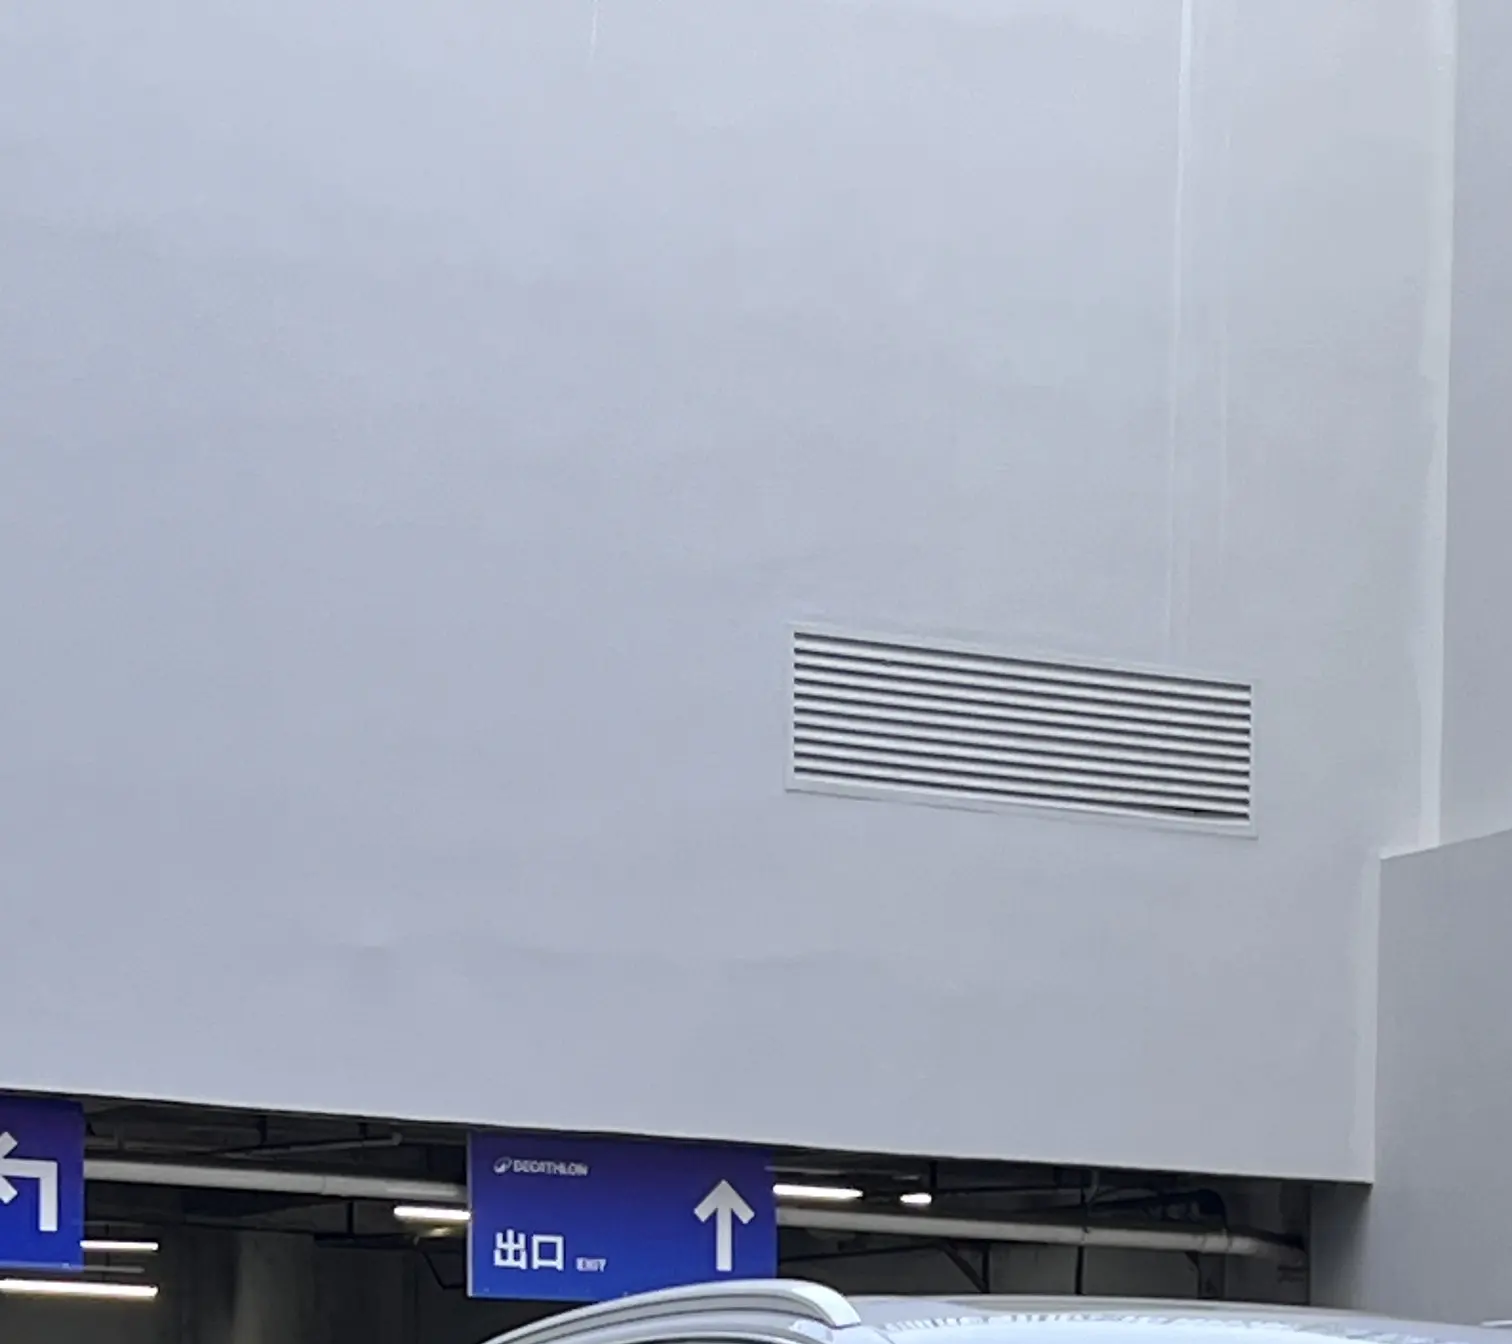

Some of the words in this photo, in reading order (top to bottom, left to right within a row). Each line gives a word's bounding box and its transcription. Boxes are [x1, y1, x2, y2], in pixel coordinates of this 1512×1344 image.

[513, 1159, 589, 1176] DECATHLON
[493, 1229, 564, 1271] 出口
[576, 1257, 607, 1272] EXIT
